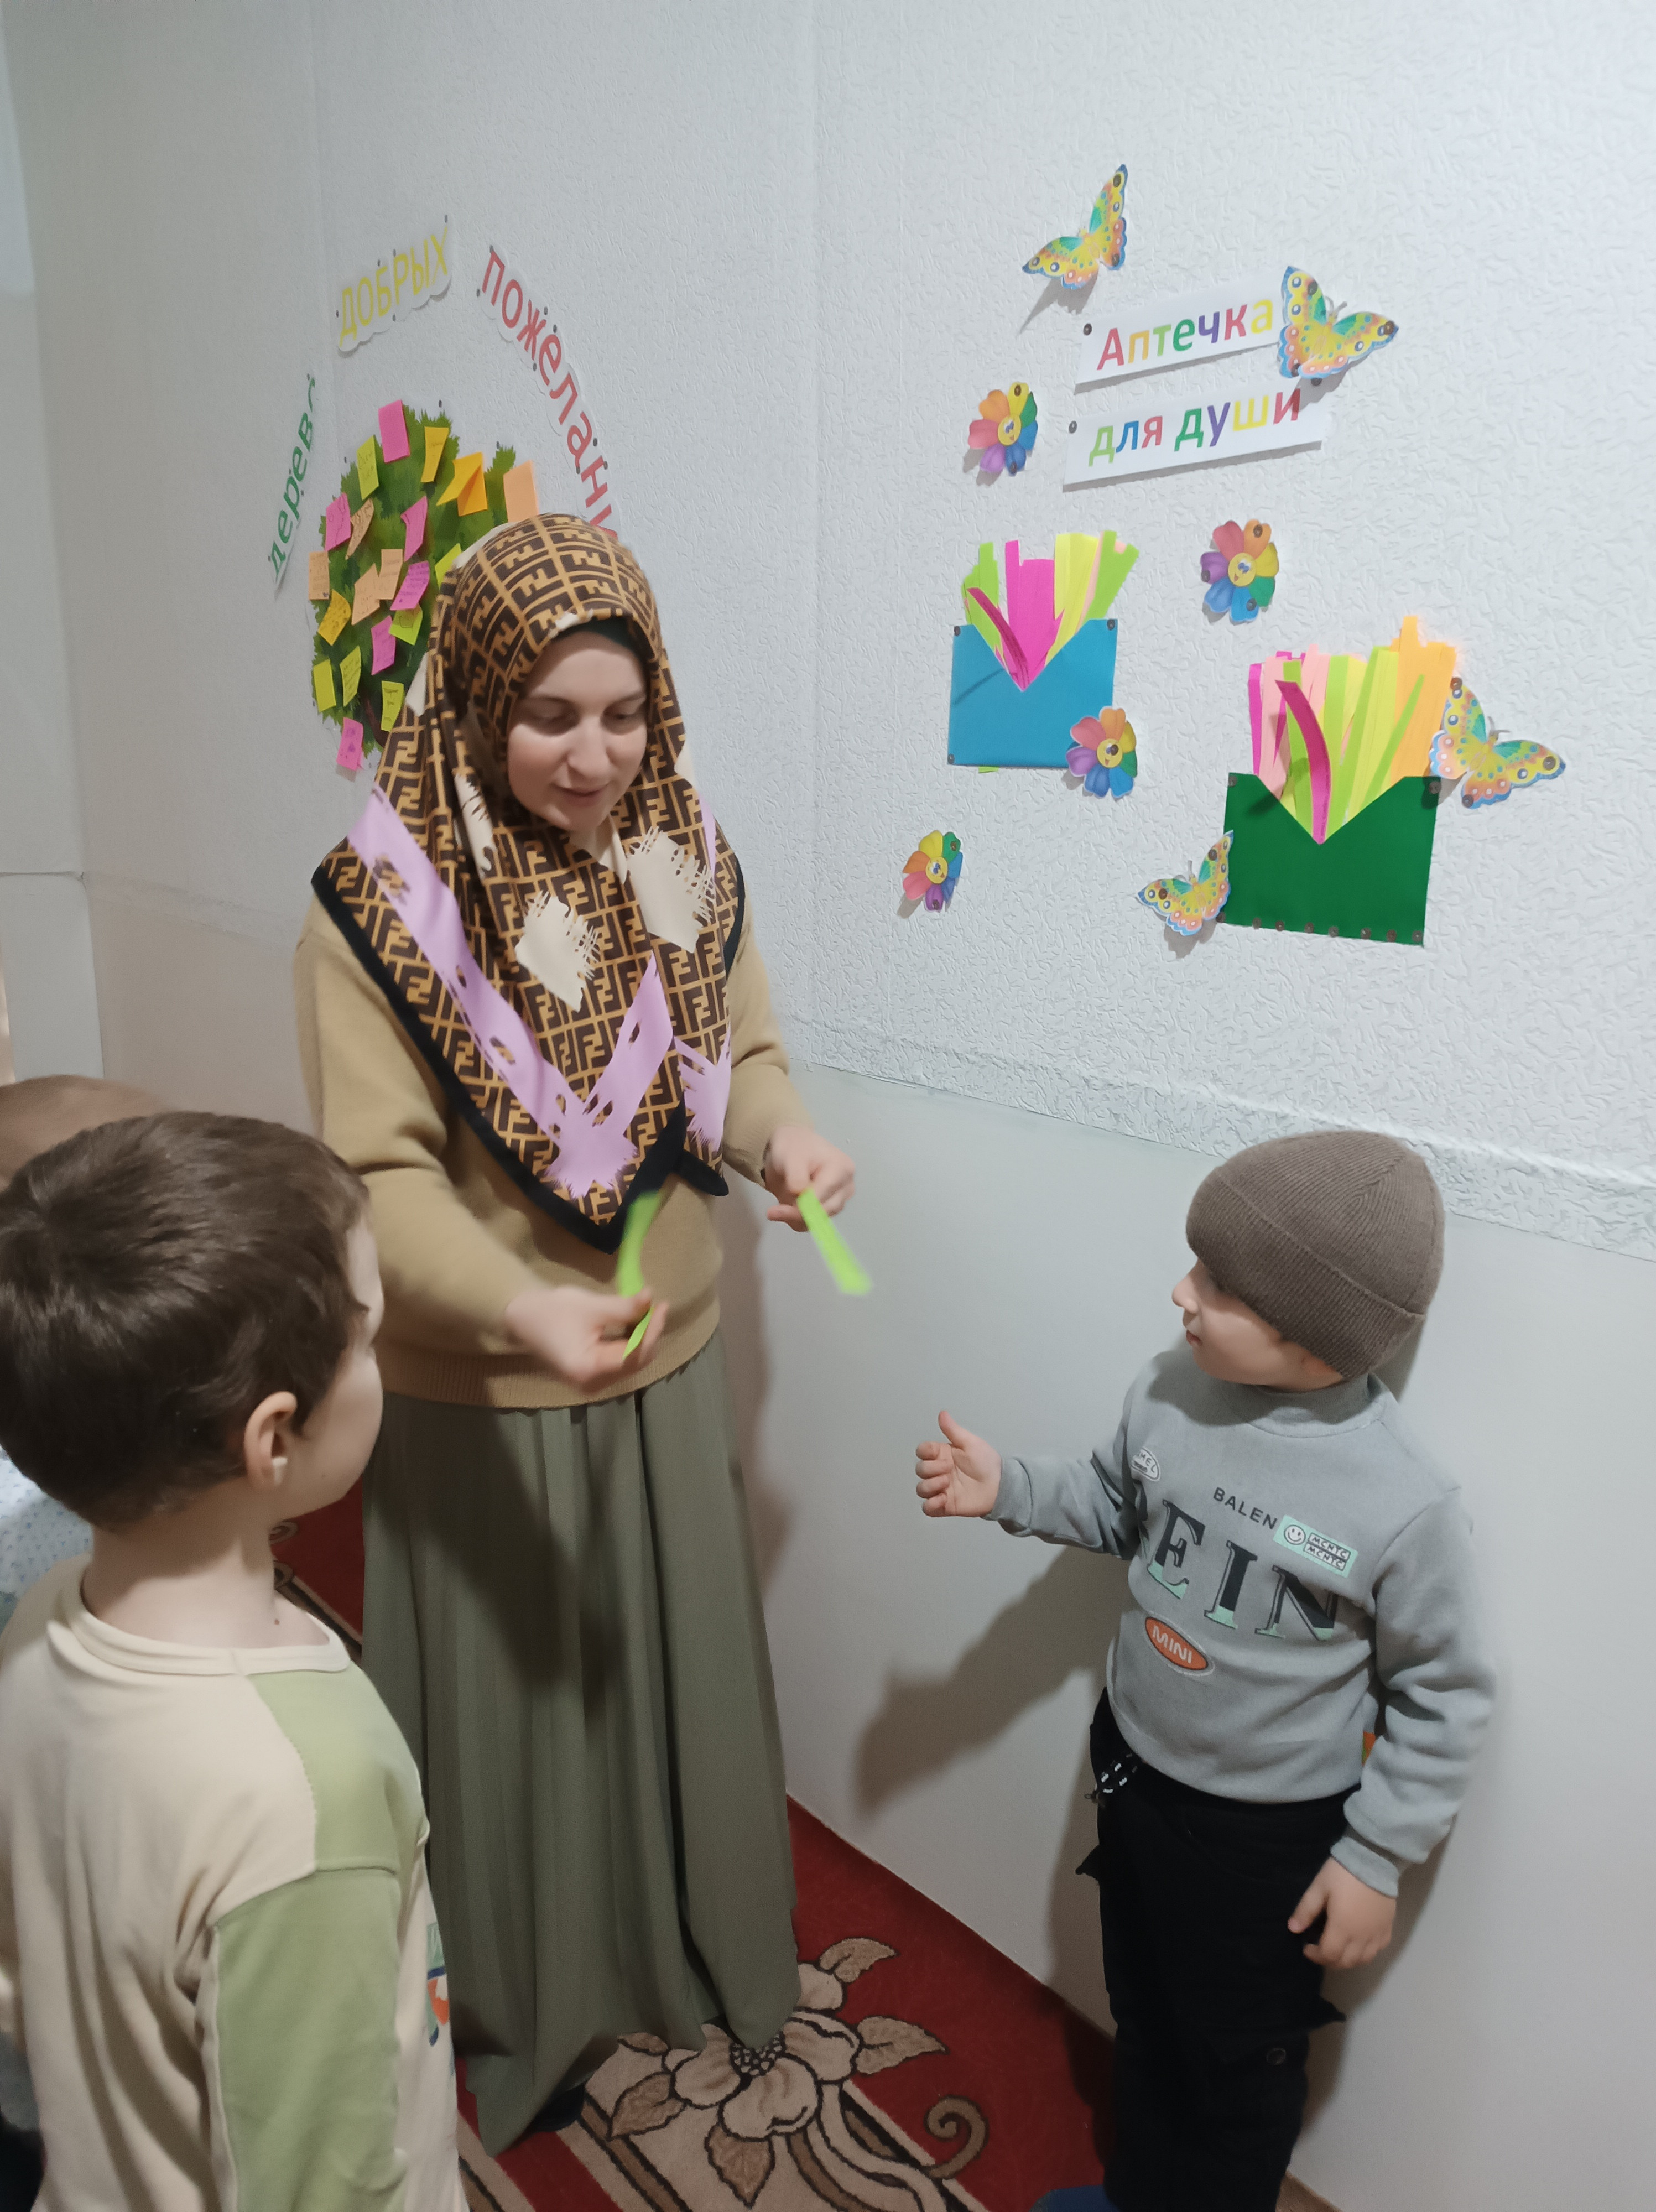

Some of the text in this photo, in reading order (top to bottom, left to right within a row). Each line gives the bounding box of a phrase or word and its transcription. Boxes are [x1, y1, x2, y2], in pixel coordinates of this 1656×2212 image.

[338, 225, 448, 348] ДОБРЫХ
[1097, 298, 1273, 371] Аптечка
[1088, 388, 1301, 467] для души
[1213, 1487, 1278, 1529] BALEN
[1152, 1625, 1192, 1664] MINI
